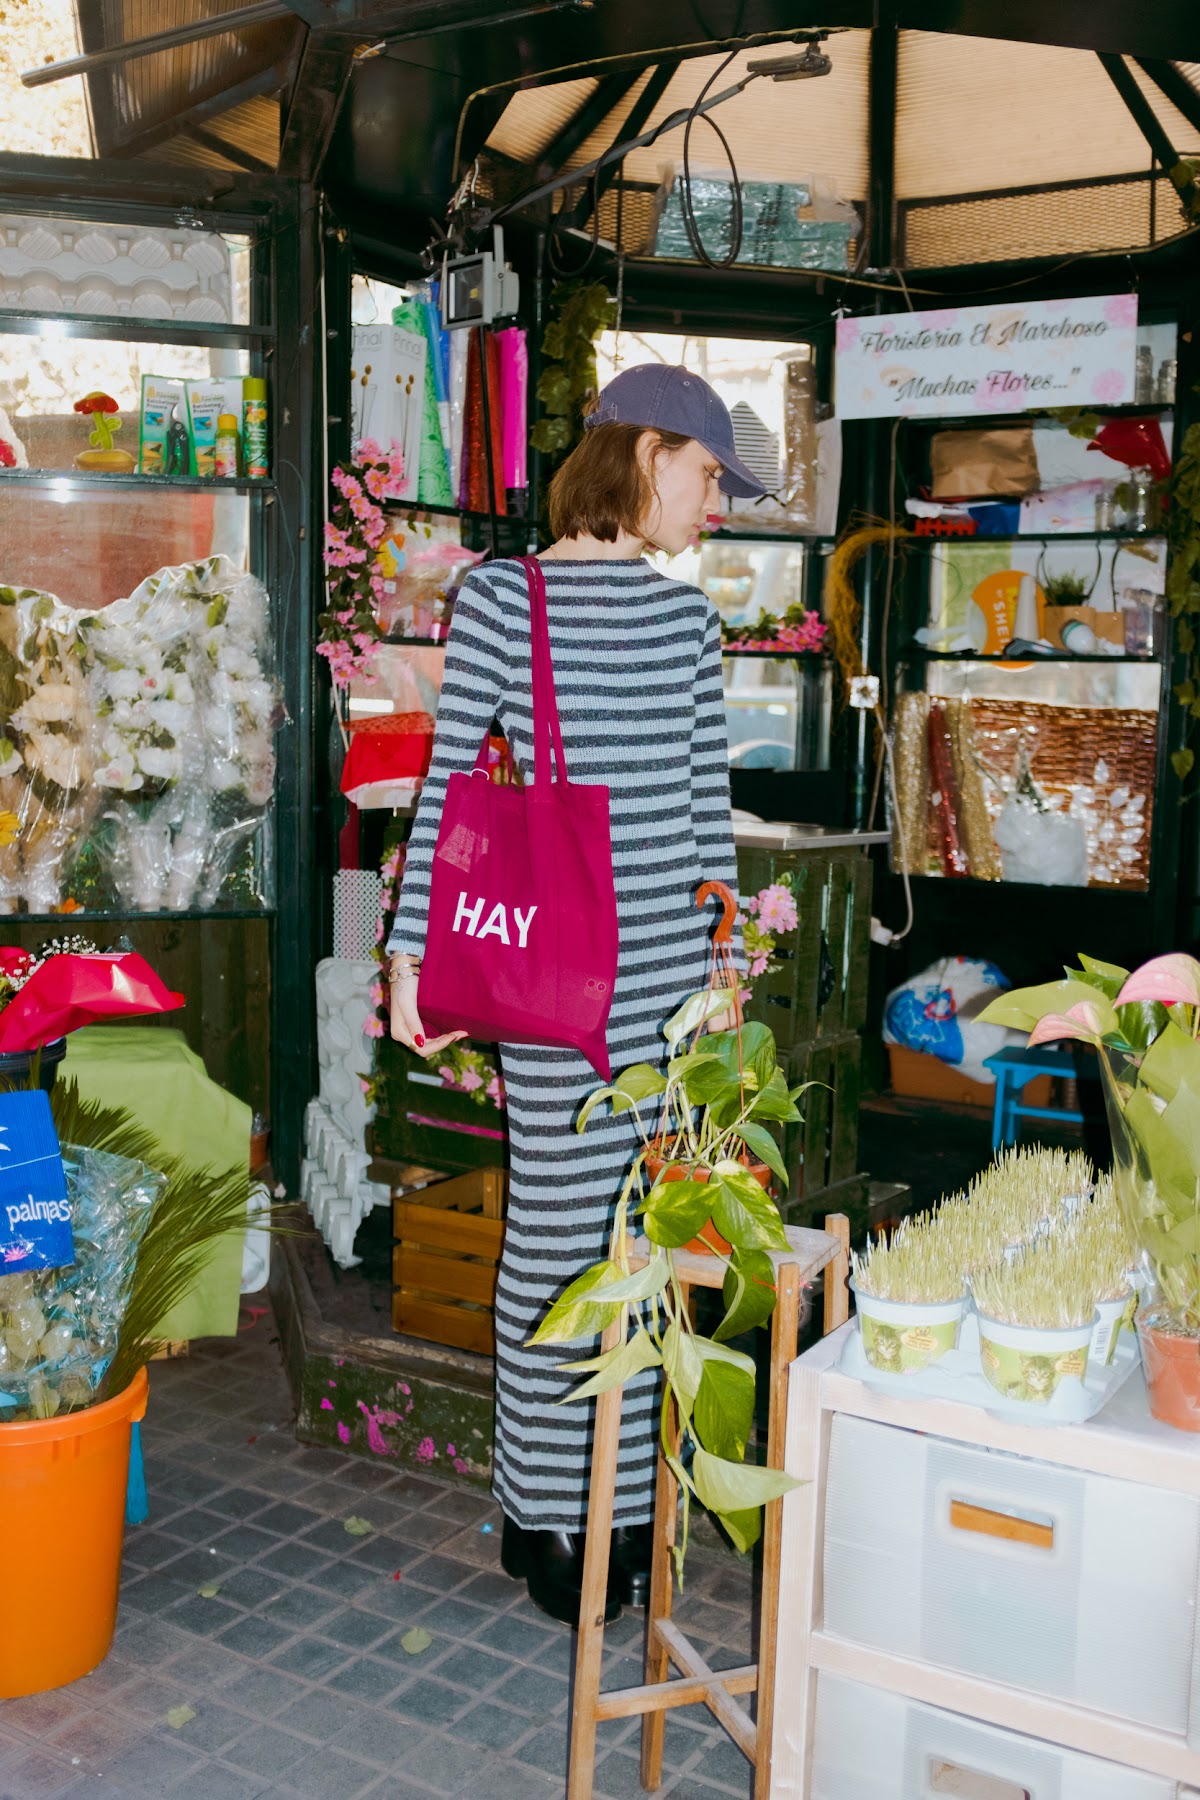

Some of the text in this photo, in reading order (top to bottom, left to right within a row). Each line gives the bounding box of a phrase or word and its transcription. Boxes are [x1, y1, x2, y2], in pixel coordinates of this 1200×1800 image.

[969, 323, 992, 346] El
[996, 317, 1109, 346] Marchoso
[452, 891, 538, 948] HAY
[6, 1193, 72, 1231] palmas
